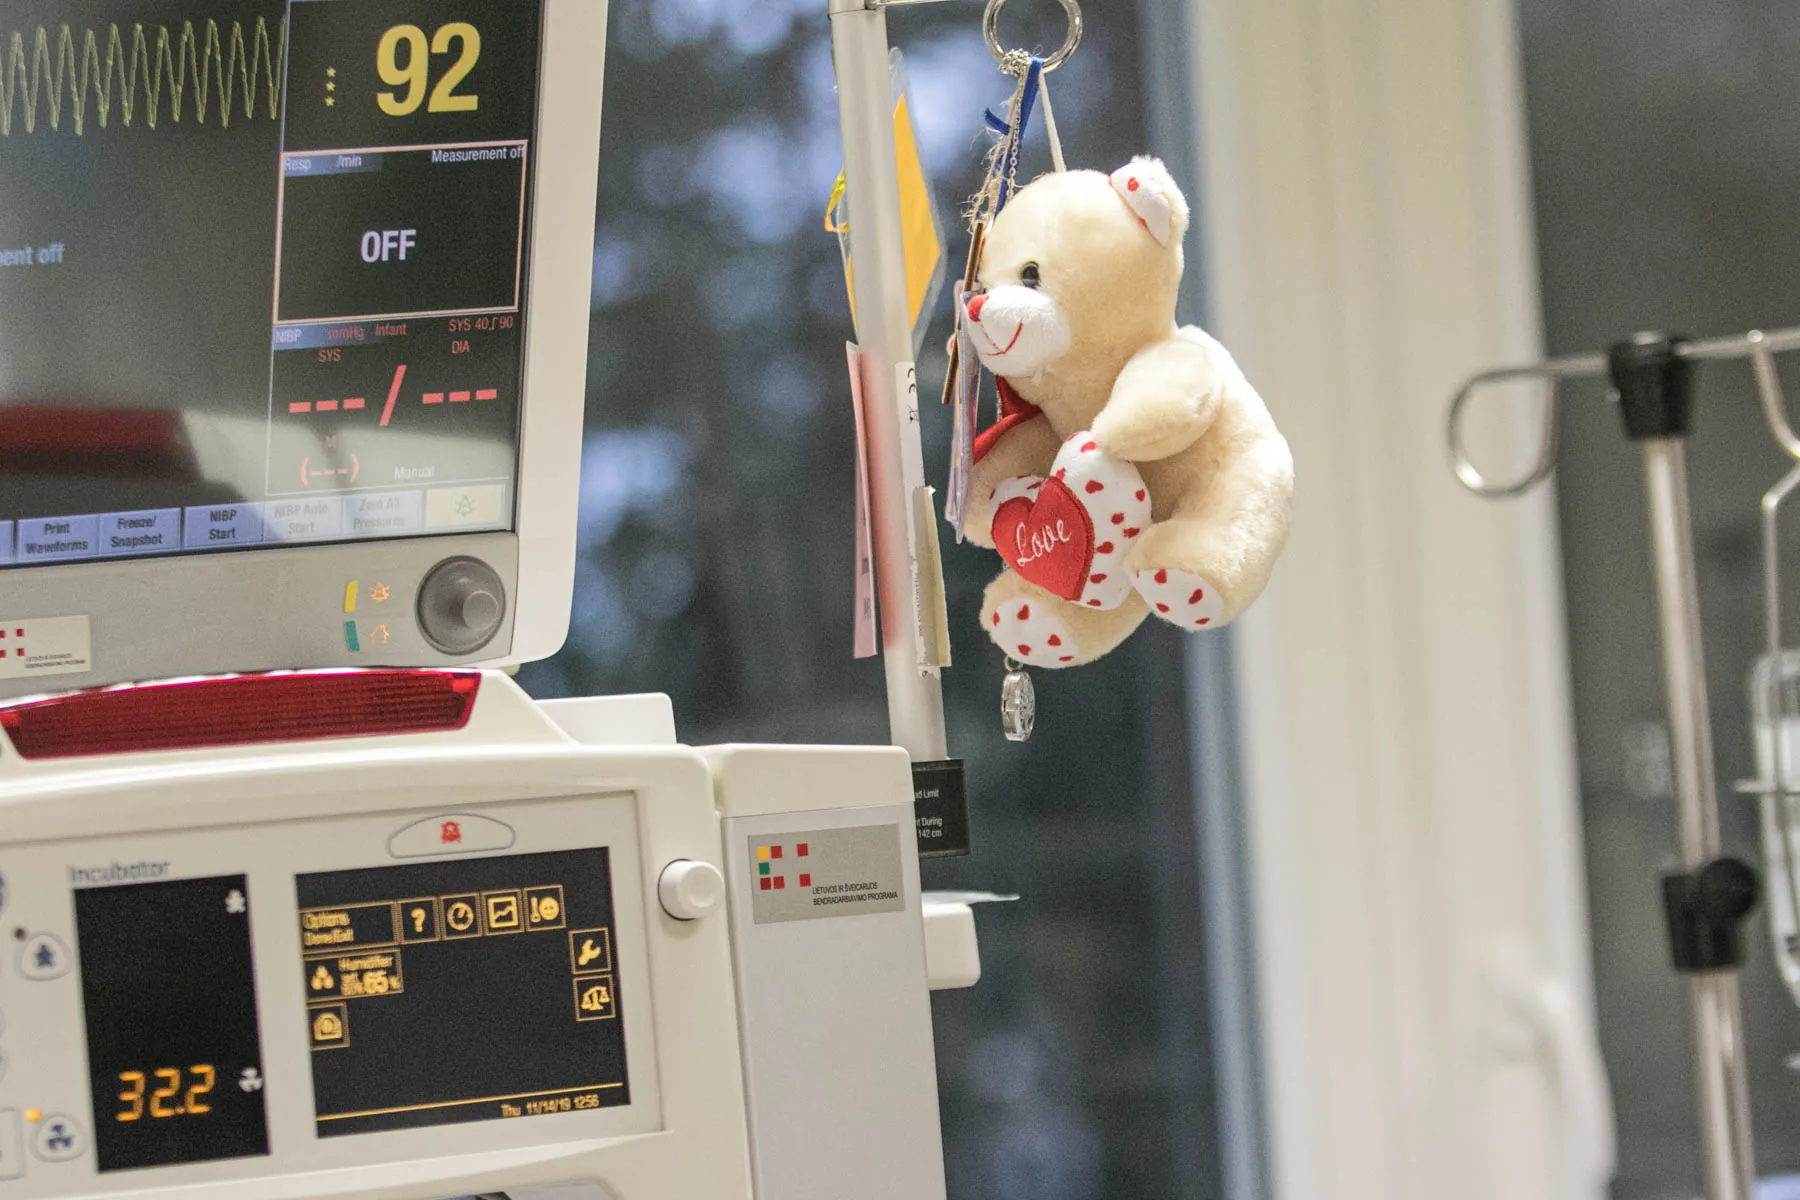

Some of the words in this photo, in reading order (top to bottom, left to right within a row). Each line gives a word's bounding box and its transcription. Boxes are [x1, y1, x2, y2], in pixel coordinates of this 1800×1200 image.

[376, 22, 481, 117] 92
[431, 147, 507, 164] Measurement
[285, 157, 311, 173] Resp
[336, 154, 362, 169] /min
[361, 229, 416, 263] OFF
[0, 247, 33, 267] ent
[38, 243, 65, 263] off
[375, 322, 407, 336] Infant
[449, 318, 471, 333] SYS
[474, 317, 489, 330] 40
[500, 315, 513, 329] 90
[275, 328, 302, 344] NIBP
[451, 341, 470, 354] DIA
[318, 349, 342, 363] SYS
[394, 465, 435, 481] Manual
[210, 509, 237, 522] NIBP
[274, 503, 301, 518] NIBP
[44, 523, 70, 535] Print
[209, 528, 236, 541] Start
[288, 521, 315, 535] Start
[26, 540, 88, 554] Waveforms
[111, 534, 162, 550] Snapshot
[1016, 519, 1072, 567] Love
[923, 789, 939, 799] Limit
[922, 817, 942, 827] During
[932, 830, 942, 838] cm
[70, 861, 169, 882] Incubator
[812, 885, 837, 894] LIETUVOS
[867, 891, 898, 901] PROGRAMA
[303, 912, 350, 929] Options
[116, 1064, 215, 1121] 32.2
[501, 1103, 521, 1117] Thu
